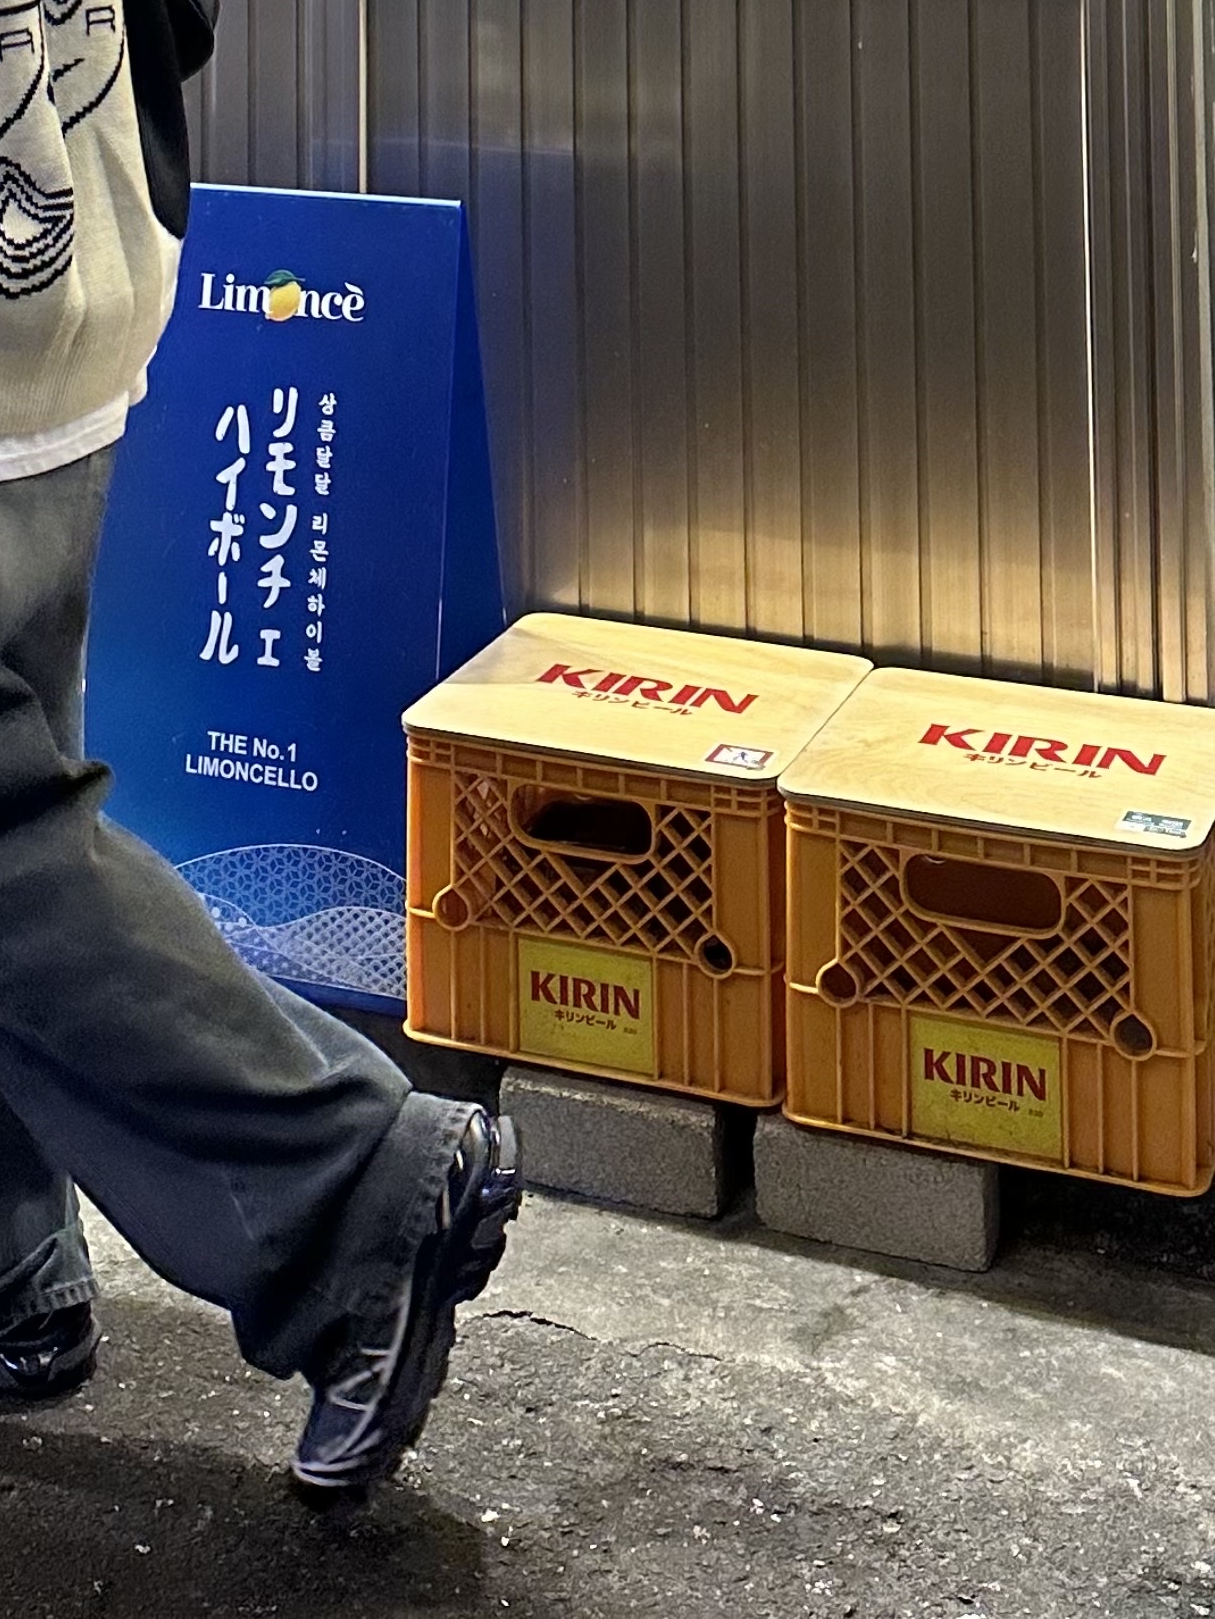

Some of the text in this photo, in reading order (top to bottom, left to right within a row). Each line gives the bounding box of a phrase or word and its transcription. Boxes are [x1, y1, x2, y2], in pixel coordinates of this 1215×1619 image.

[314, 392, 337, 496] 상큼달달
[199, 404, 250, 665] ハイボール
[257, 386, 299, 667] リモンチェ
[536, 663, 760, 715] KIRIN
[572, 690, 694, 716] キリンビール
[207, 731, 298, 762] THE No.1
[918, 723, 1167, 776] KIRIN
[963, 752, 1103, 779] キリンビール
[186, 754, 319, 792] LIMONCELLO
[530, 970, 641, 1020] KIRIN
[555, 1009, 617, 1031] キリンビール
[924, 1047, 1046, 1102] KIRIN
[950, 1088, 1021, 1112] キリンビール
